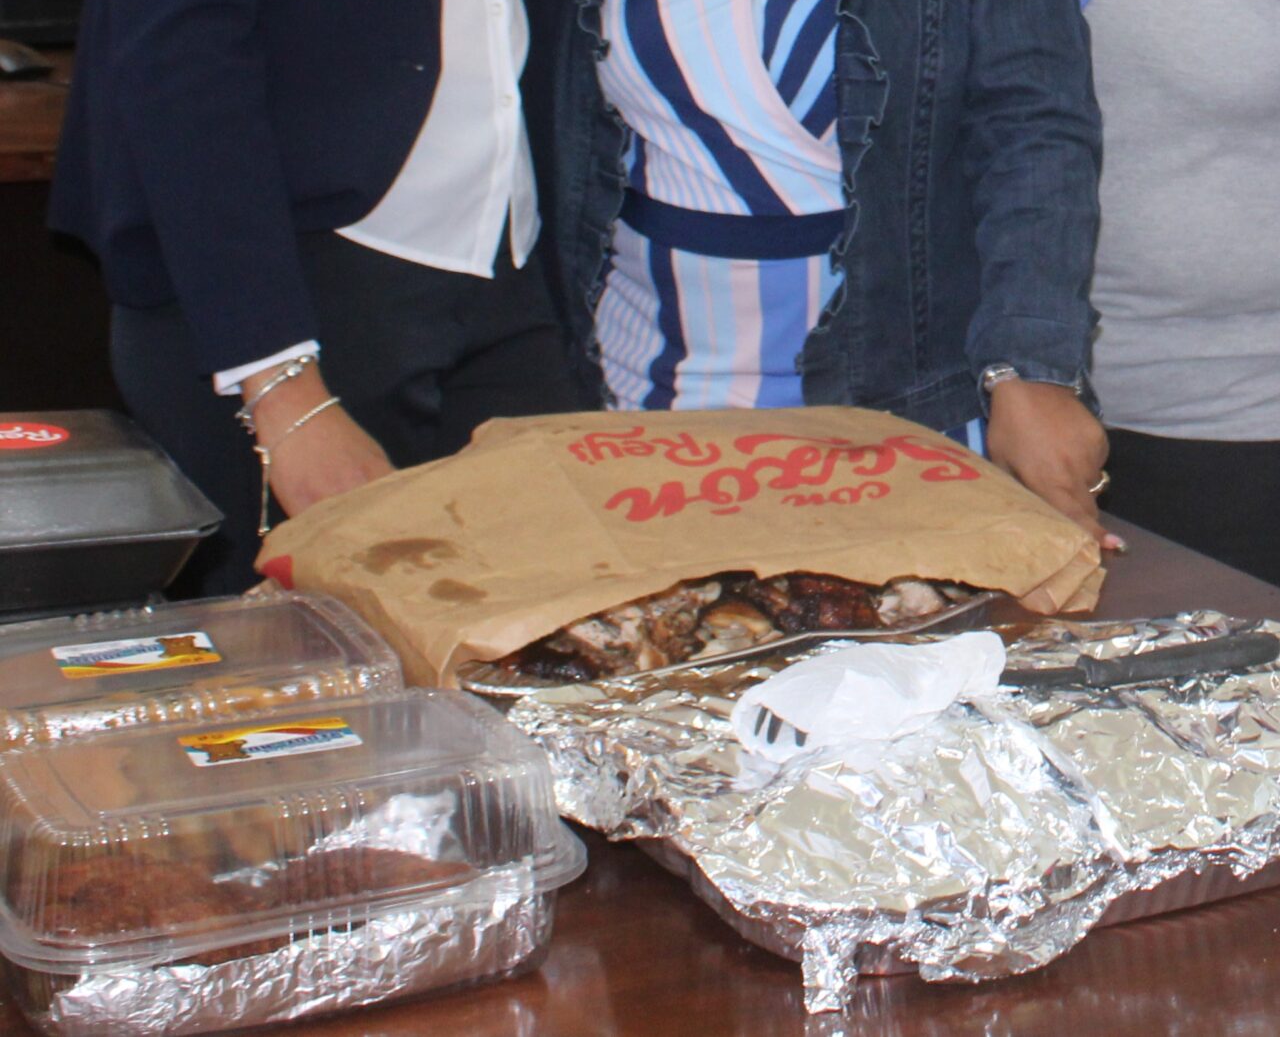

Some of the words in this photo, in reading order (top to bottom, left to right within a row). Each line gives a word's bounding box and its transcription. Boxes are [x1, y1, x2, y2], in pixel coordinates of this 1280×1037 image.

[567, 426, 722, 466] Rey's
[603, 433, 981, 523] Sazón
[780, 480, 891, 507] con
